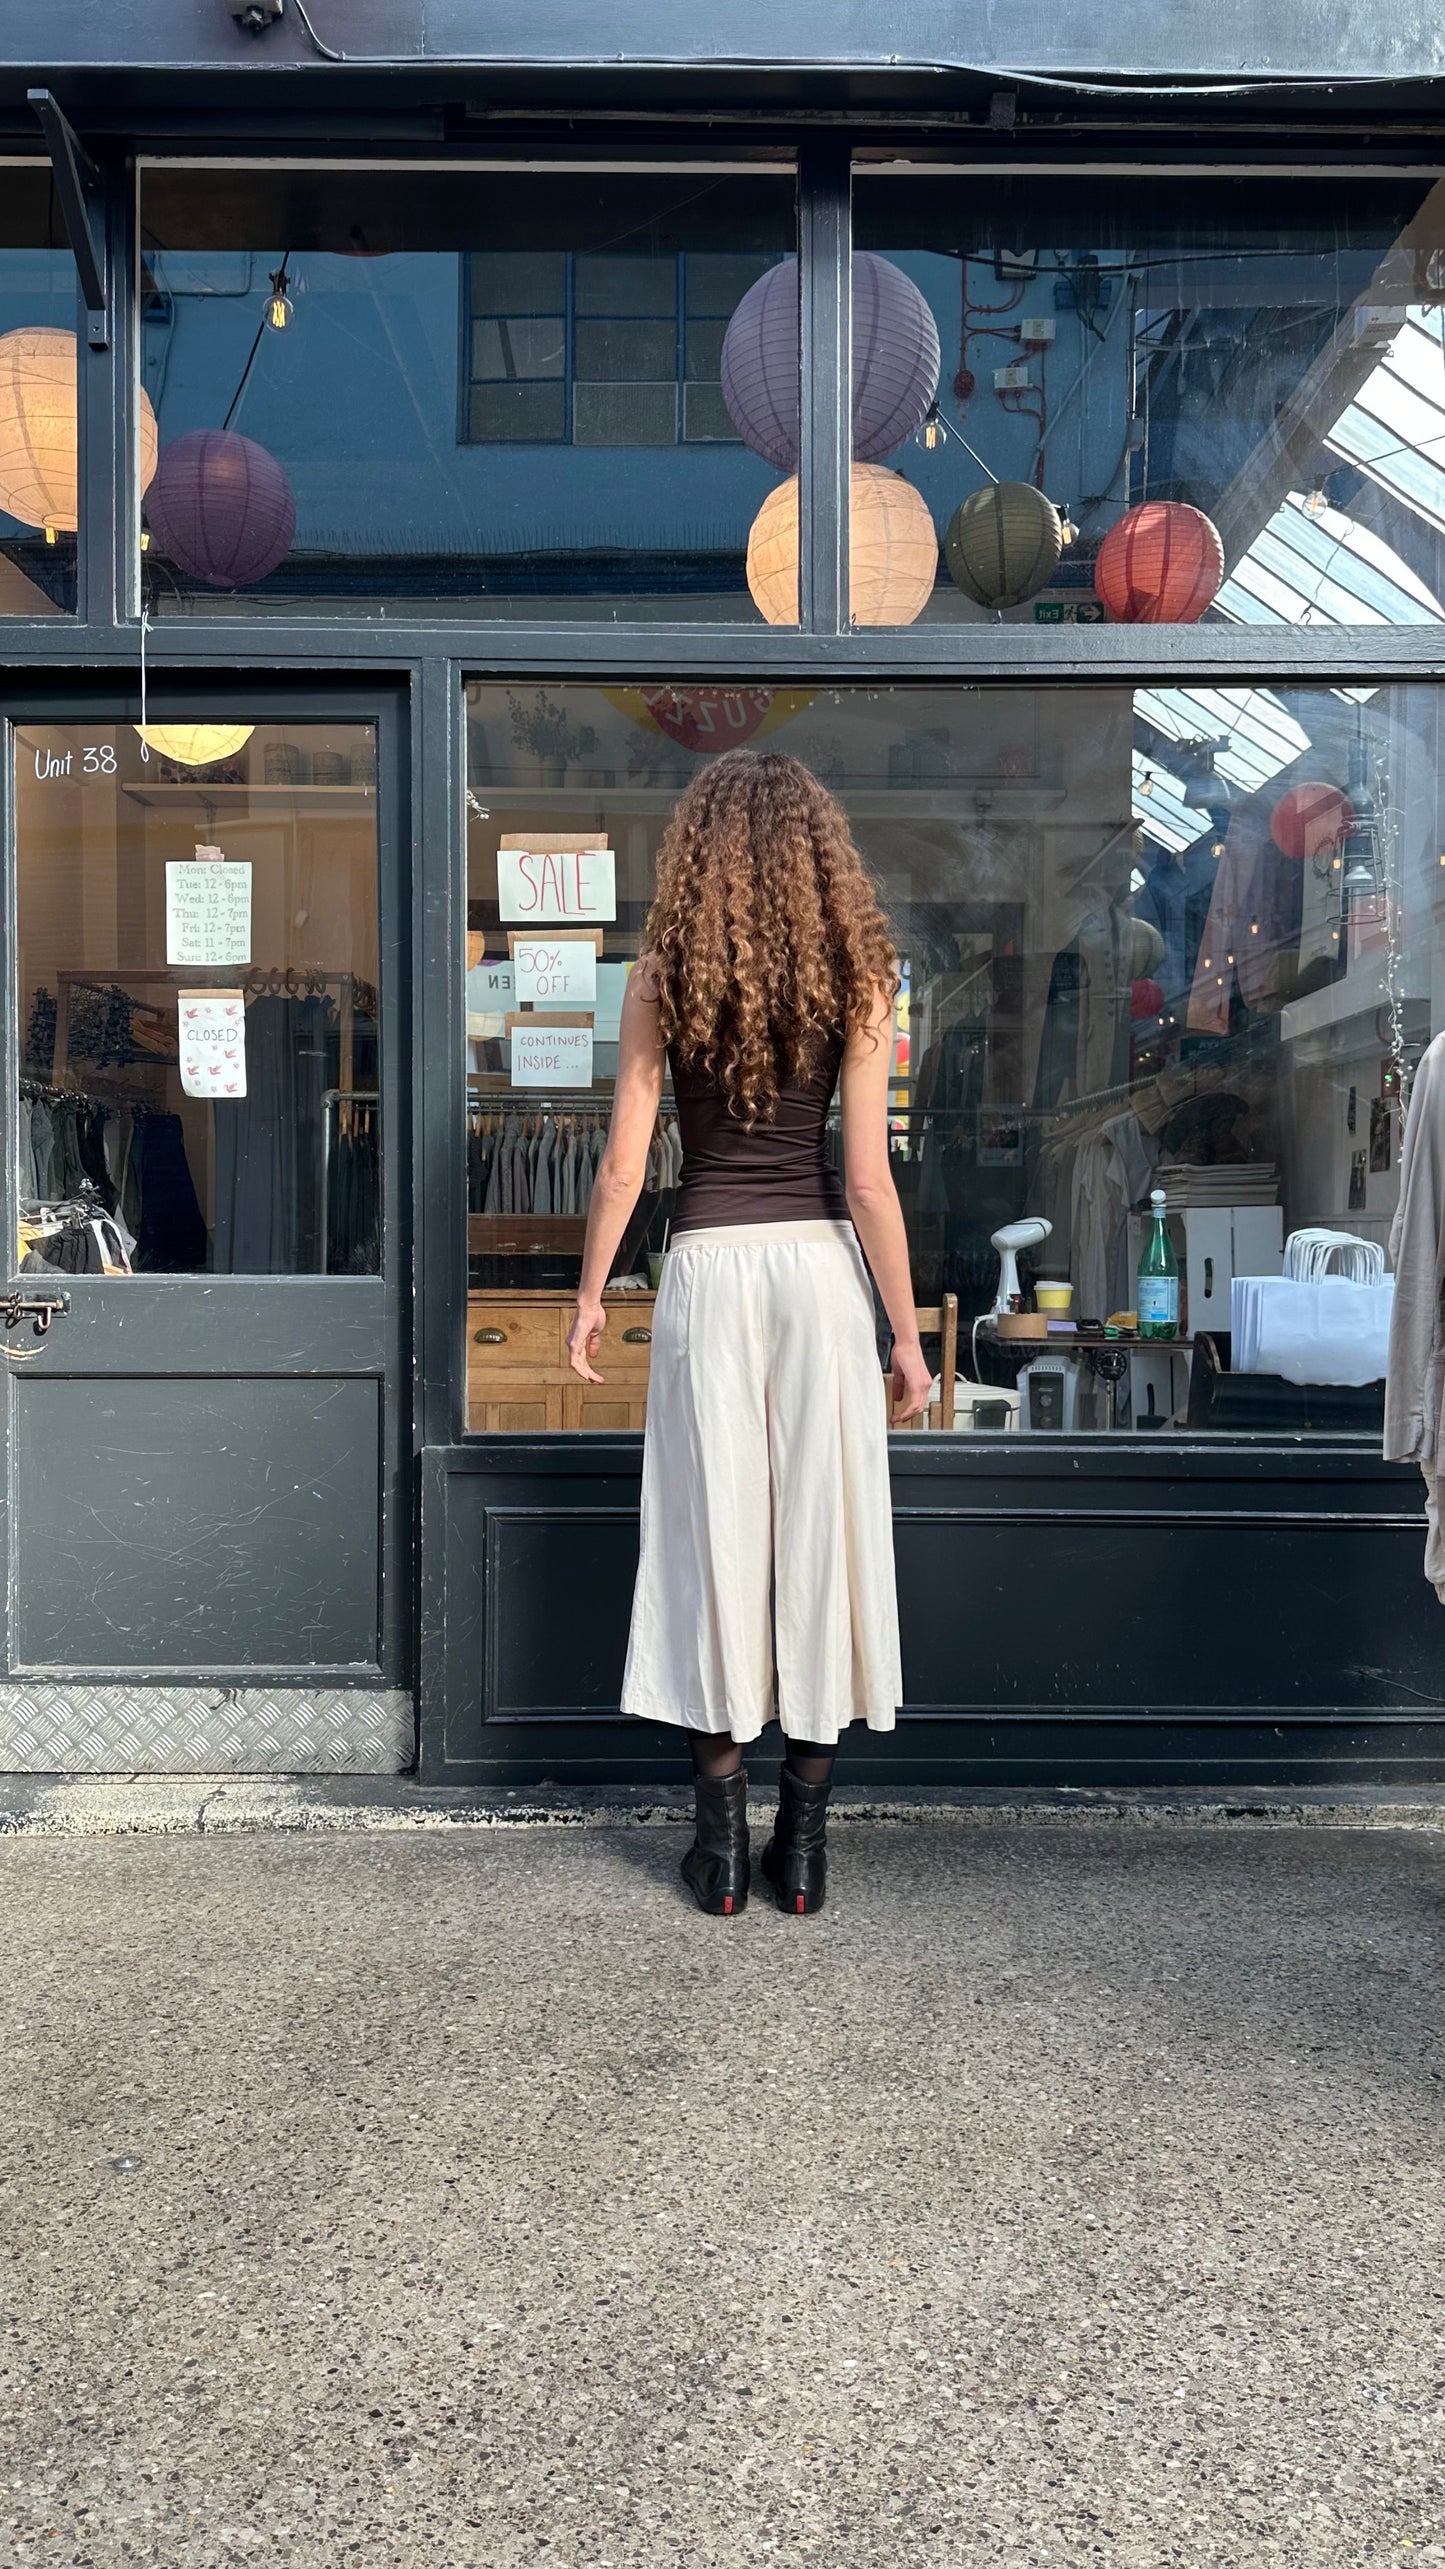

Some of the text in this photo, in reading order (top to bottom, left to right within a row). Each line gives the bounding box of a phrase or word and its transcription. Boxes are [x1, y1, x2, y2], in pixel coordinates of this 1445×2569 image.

[34, 745, 118, 780] Unit 38
[178, 864, 245, 874] Mon: Closed
[176, 879, 200, 889] Tue:
[205, 879, 216, 889] 12
[225, 879, 247, 891] 6pm
[518, 854, 597, 916] SALE
[175, 894, 204, 903] Wed:
[208, 894, 219, 903] 12
[228, 894, 249, 906] 6pm
[172, 908, 199, 918] Thu:
[207, 908, 218, 918] 12
[227, 908, 248, 920] 7pm
[182, 923, 200, 932] Fri:
[204, 922, 216, 932] 12
[225, 924, 246, 935] 7pm
[182, 938, 200, 947] Sat:
[205, 938, 214, 947] 11
[226, 938, 246, 950] 7pm
[177, 952, 200, 962] Sun:
[205, 952, 217, 962] 12
[226, 952, 247, 964] 6pm
[518, 948, 562, 973] 50%
[536, 975, 570, 995] OFF
[186, 1028, 238, 1042] CLOSED
[520, 1034, 589, 1048] CONTINUES
